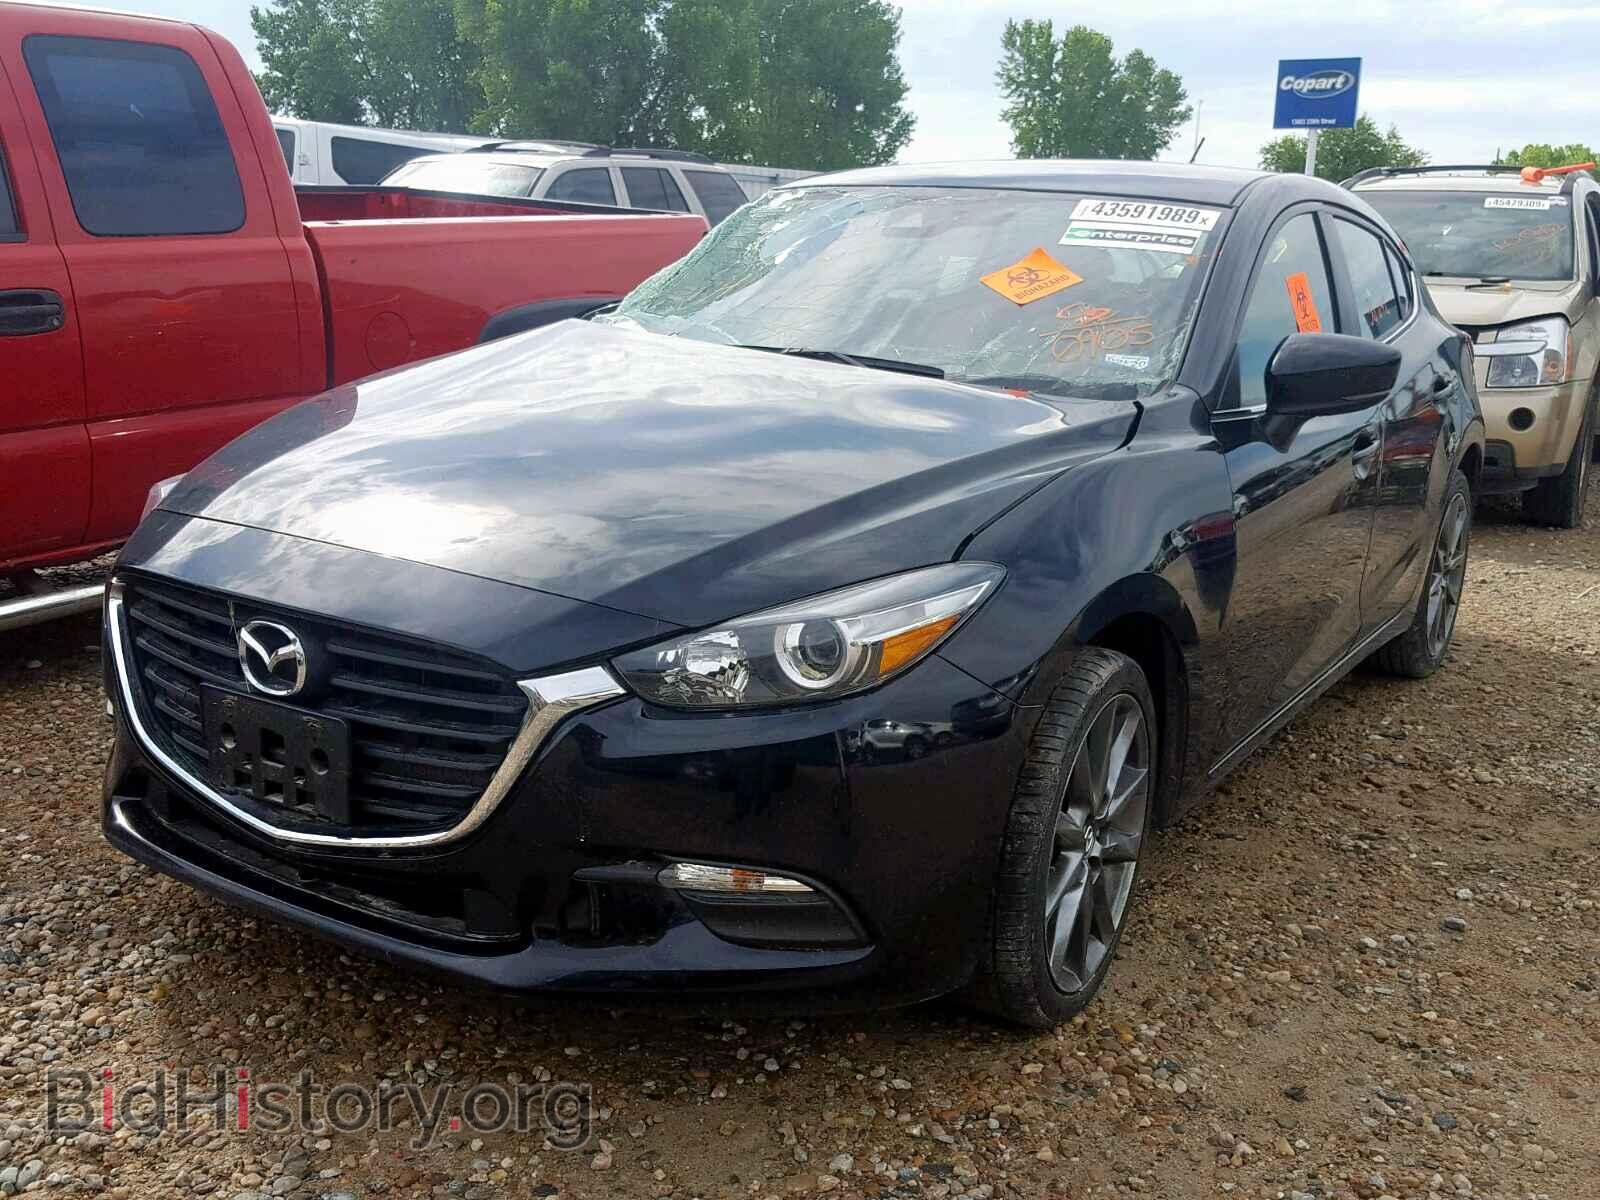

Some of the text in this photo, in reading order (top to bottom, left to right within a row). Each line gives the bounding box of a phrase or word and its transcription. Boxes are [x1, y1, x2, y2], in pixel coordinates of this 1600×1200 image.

[1280, 74, 1346, 93] Copart
[1091, 201, 1201, 225] 43591989
[1072, 229, 1194, 247] enterprise
[1013, 273, 1071, 300] BIOHAZARD
